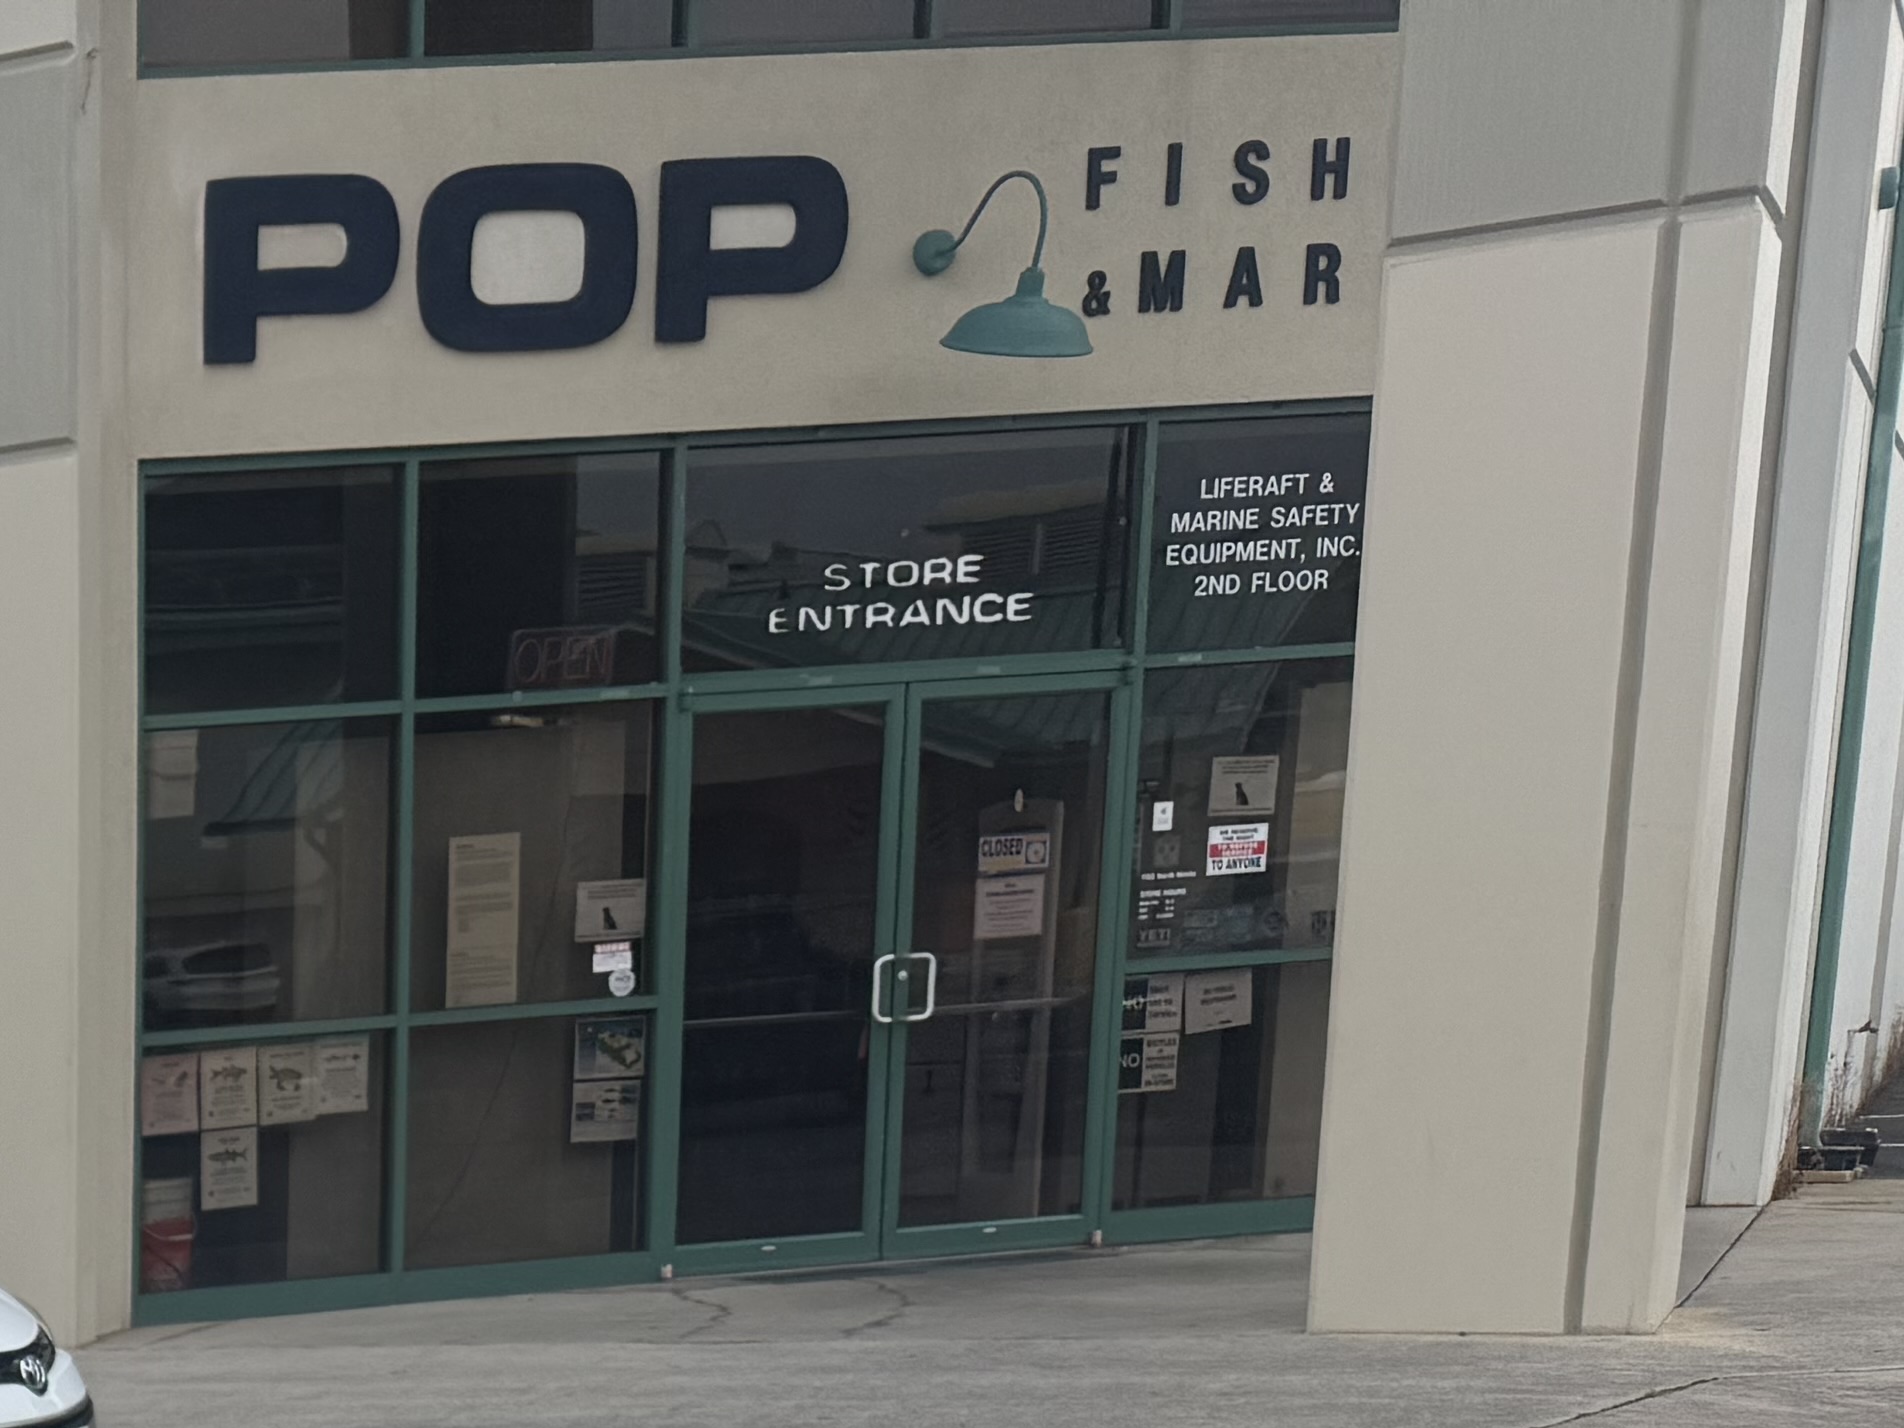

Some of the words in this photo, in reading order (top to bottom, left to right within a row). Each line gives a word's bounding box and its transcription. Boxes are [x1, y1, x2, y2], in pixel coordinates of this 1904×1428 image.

[1085, 137, 1351, 211] FISH
[203, 154, 850, 365] POP
[1200, 473, 1310, 500] LIFERAFT
[1318, 472, 1335, 494] &
[1170, 508, 1260, 533] MARINE
[1270, 503, 1361, 529] SAFETY
[1165, 537, 1307, 566] EQUIPMENT,
[1316, 535, 1361, 559] INC.
[823, 554, 985, 591] STORE
[1194, 573, 1241, 597] 2ND
[1251, 569, 1329, 594] FLOOR
[768, 592, 1035, 634] ENTRANCE
[514, 636, 613, 683] OPEN
[981, 837, 1023, 858] CLOSED
[1212, 859, 1223, 871] TO
[1226, 857, 1262, 870] ANYONE
